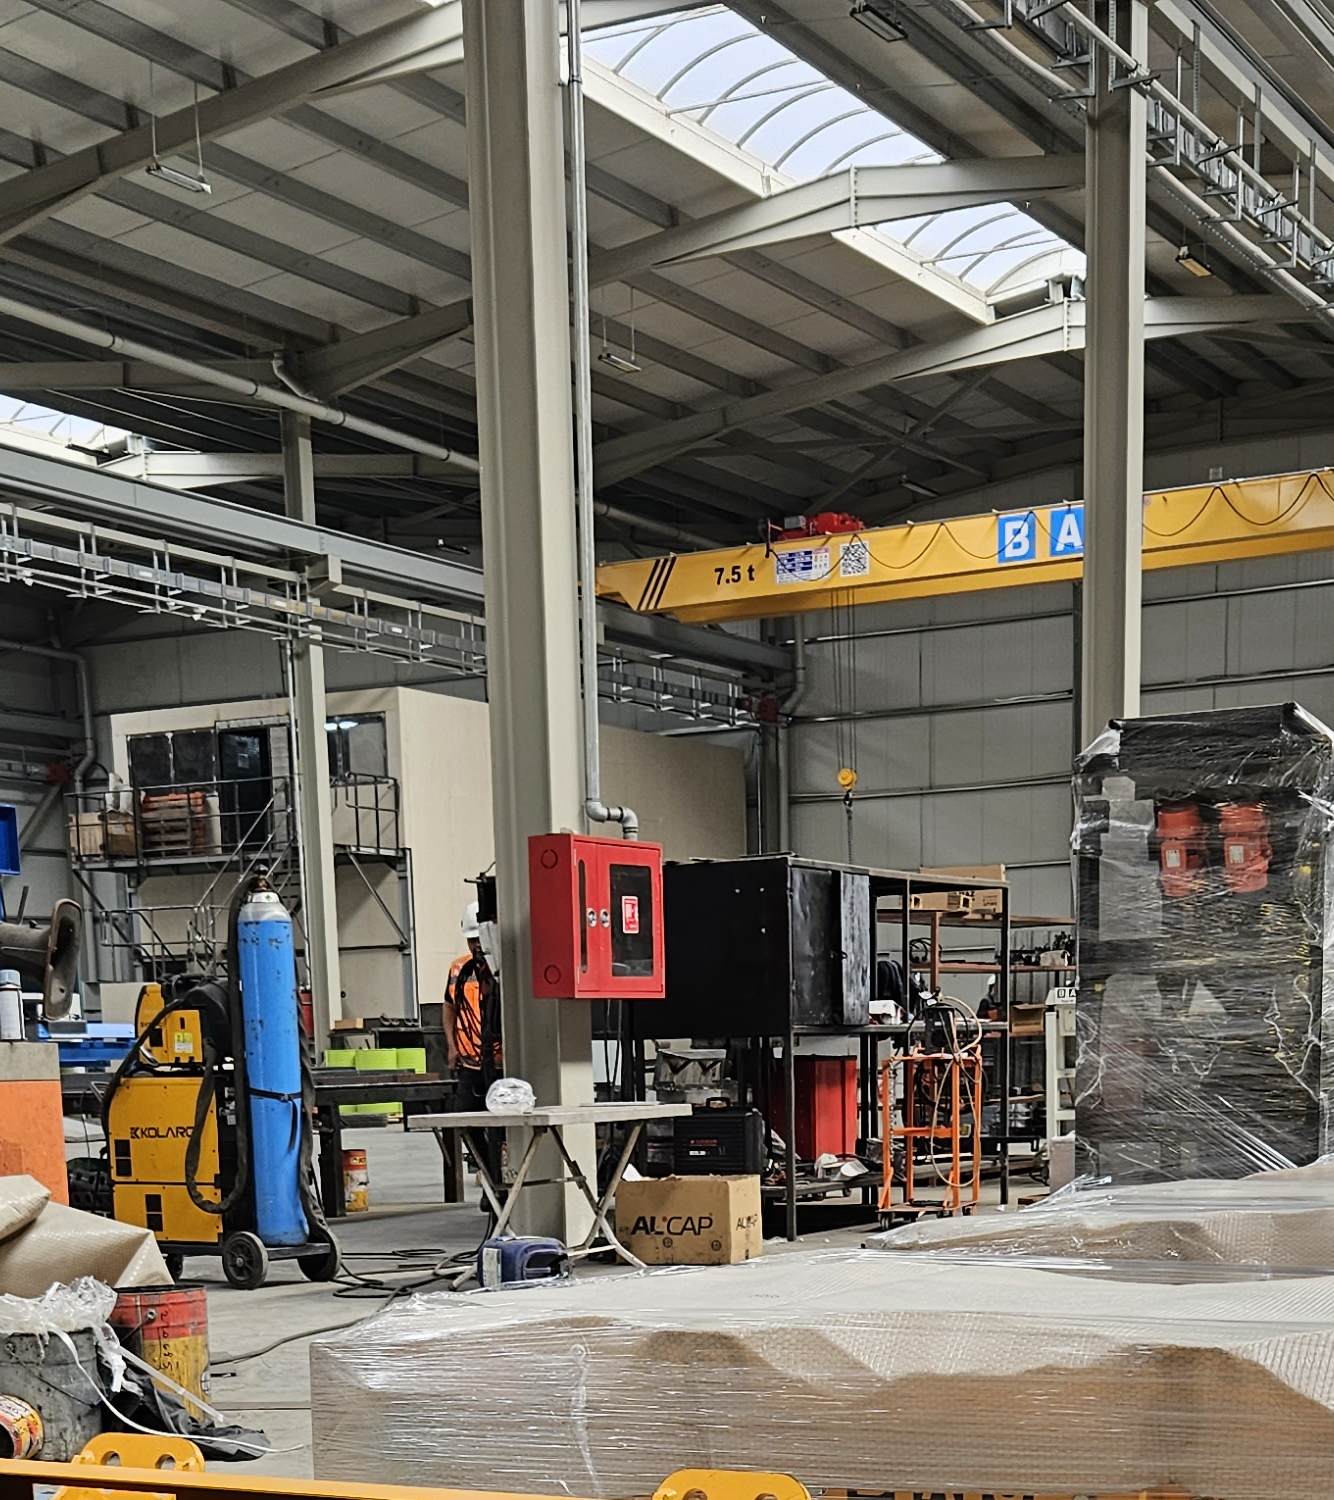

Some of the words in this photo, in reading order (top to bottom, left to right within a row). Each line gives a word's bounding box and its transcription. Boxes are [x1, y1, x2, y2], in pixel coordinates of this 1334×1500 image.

[1005, 513, 1084, 558] BA
[714, 565, 742, 585] 7.5
[747, 564, 756, 581] t
